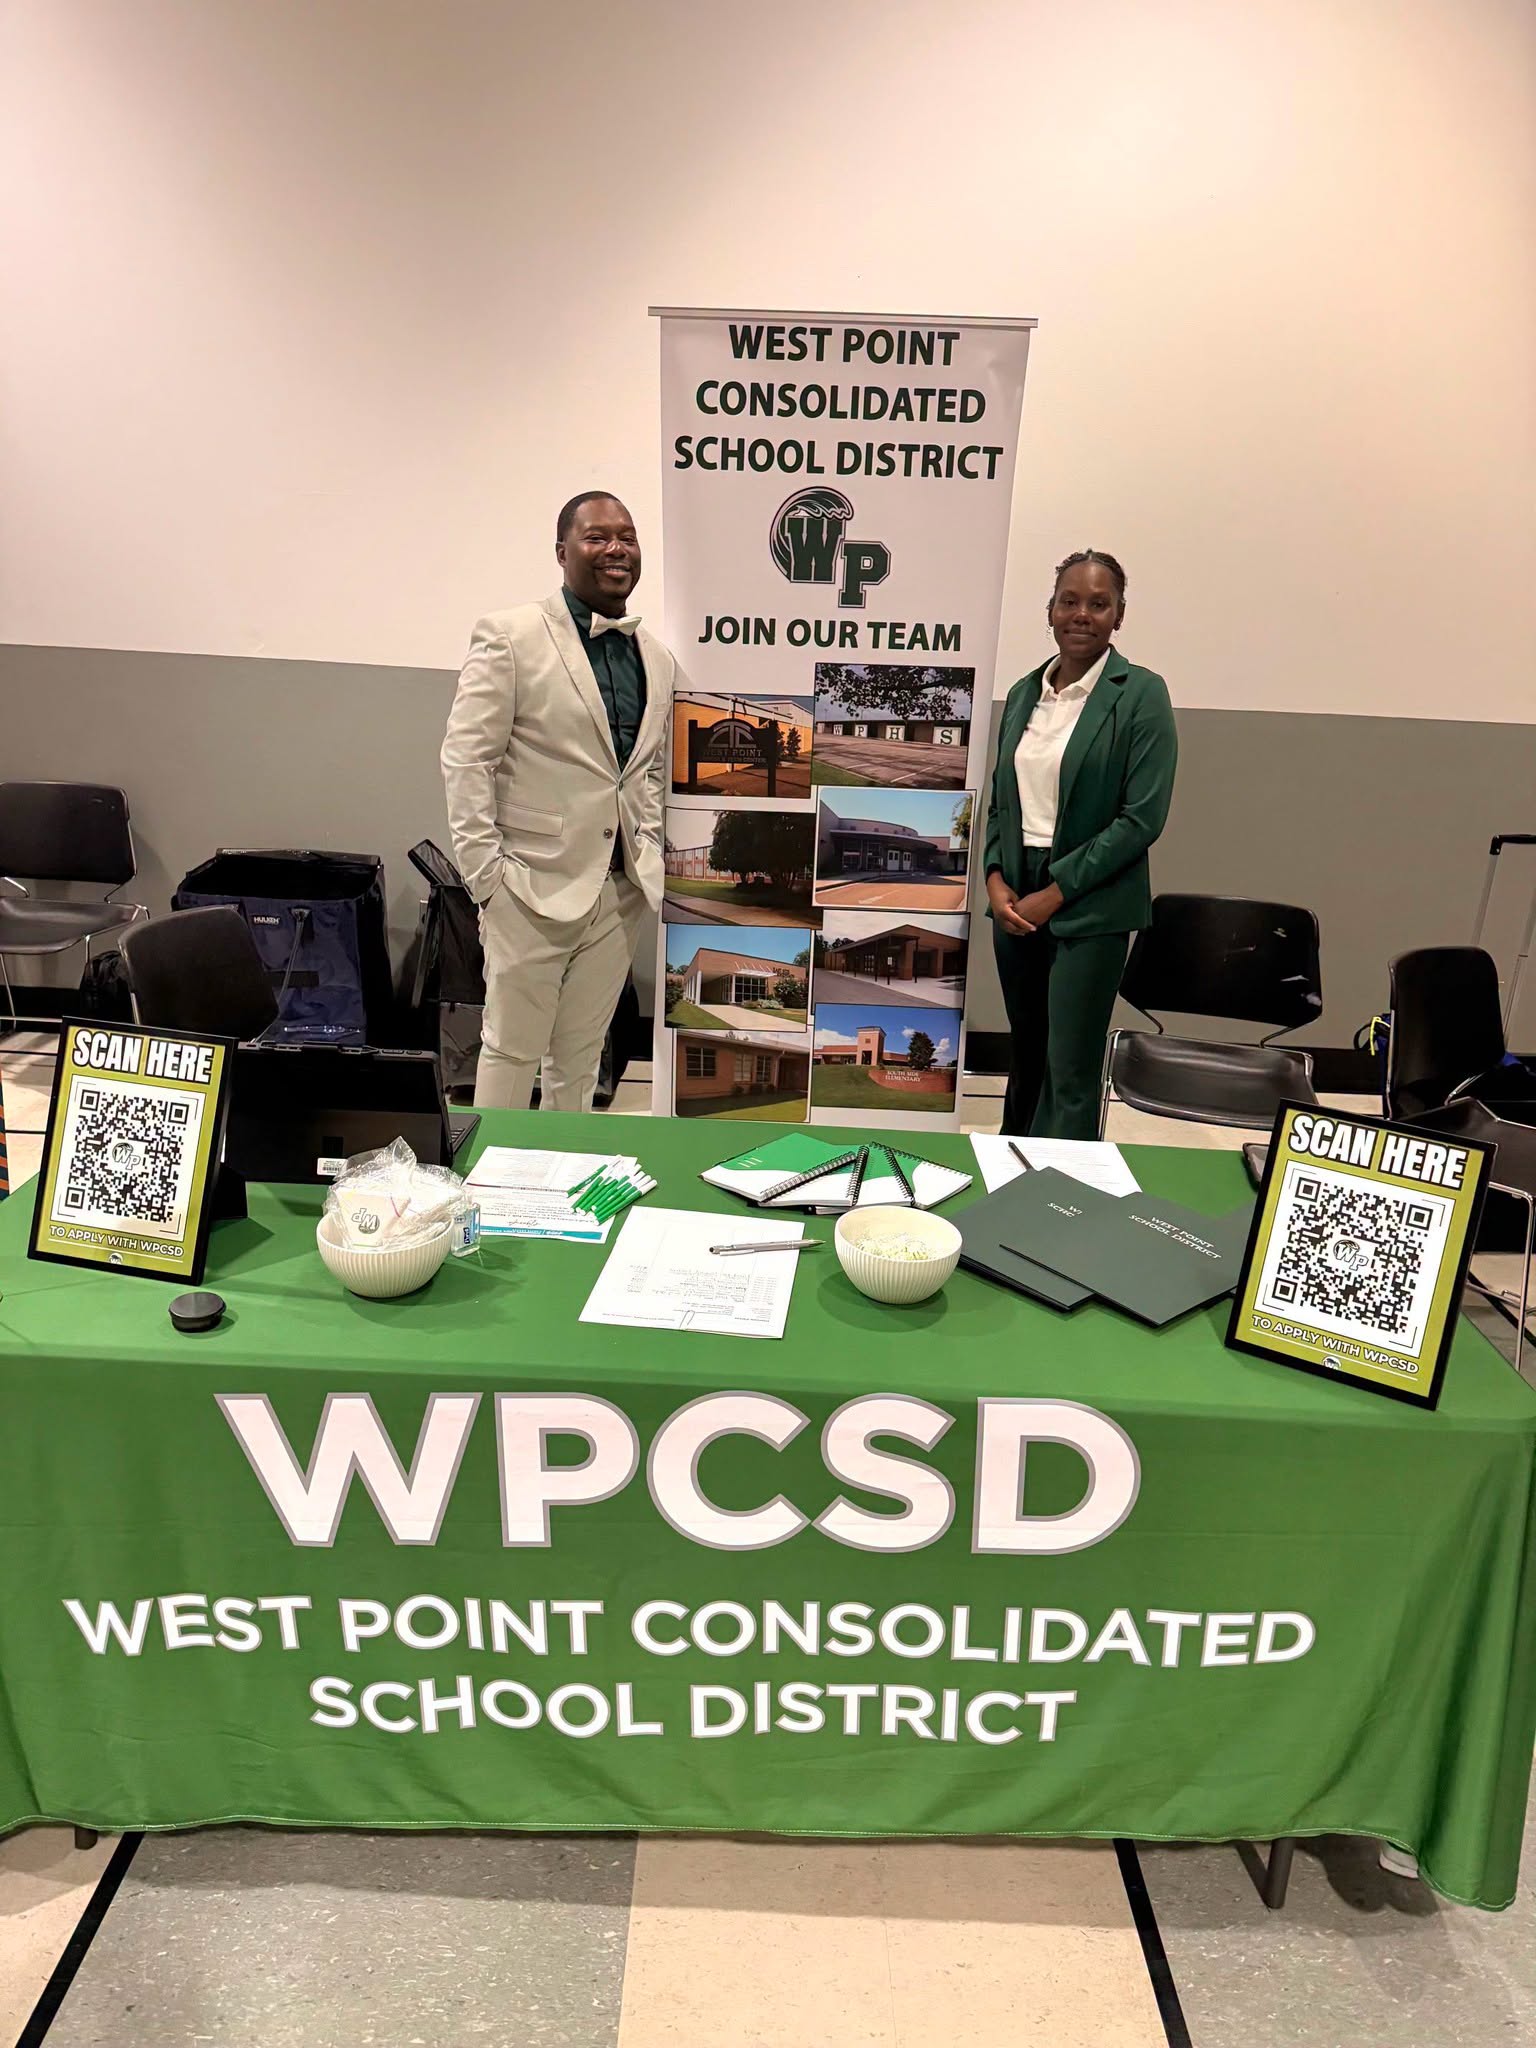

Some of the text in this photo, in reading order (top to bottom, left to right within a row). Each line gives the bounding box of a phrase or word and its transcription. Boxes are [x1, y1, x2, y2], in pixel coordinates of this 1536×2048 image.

[729, 325, 960, 366] WEST POINT
[696, 380, 986, 424] CONSOLIDATED
[674, 436, 1004, 480] SCHOOL DISTRICT
[698, 616, 962, 652] JOIN OUR TEAM
[72, 1029, 215, 1084] SCAN HERE
[1288, 1112, 1469, 1191] SCAN HERE
[50, 1226, 183, 1257] TO APPLY WITH WPCSD
[1128, 1214, 1222, 1259] SCHOOL DISTRICT
[1151, 1217, 1215, 1248] WEST POINT
[1252, 1315, 1419, 1374] TO APPLY WITH WPCSD
[214, 1391, 1141, 1554] WPCSD
[62, 1593, 1316, 1668] WEST POINT CONSOLIDATED
[310, 1674, 1077, 1744] SCHOOL DISTRICT
